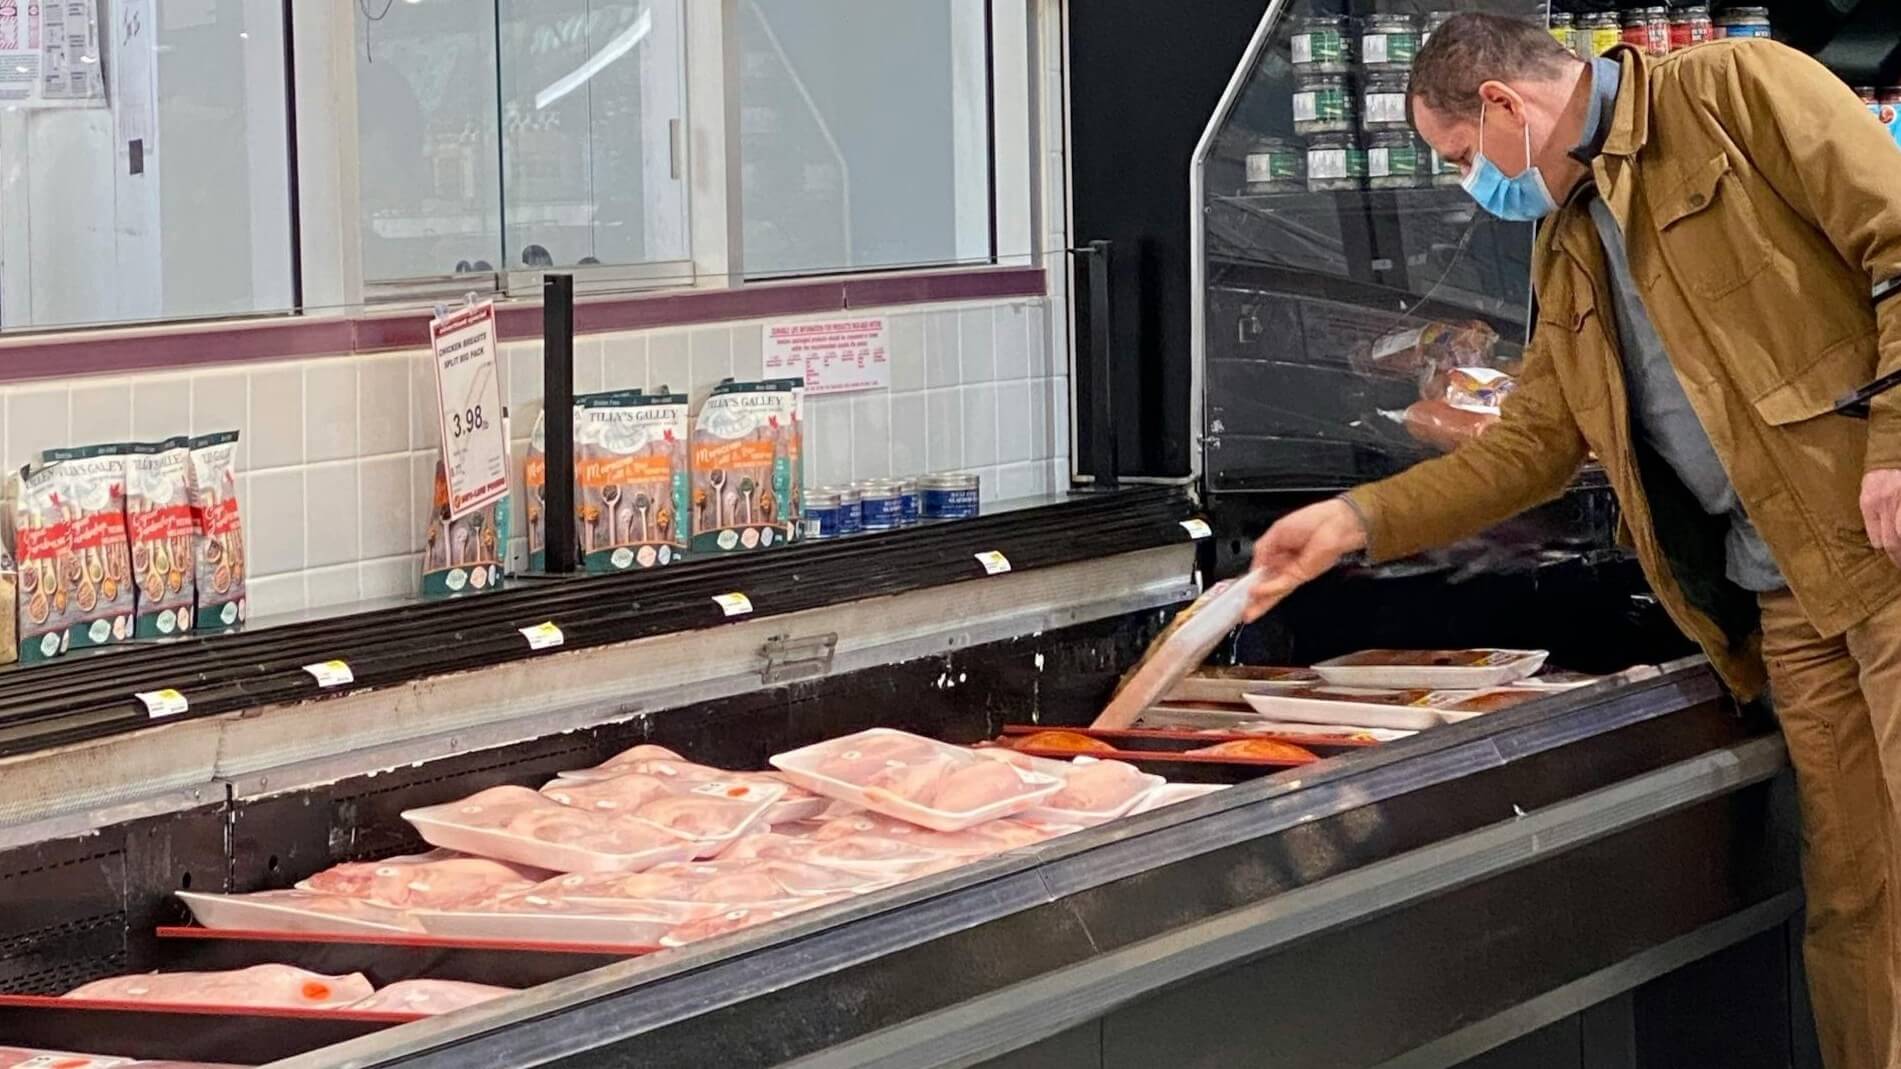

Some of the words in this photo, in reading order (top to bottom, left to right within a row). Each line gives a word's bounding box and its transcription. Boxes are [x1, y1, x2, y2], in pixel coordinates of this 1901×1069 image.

[439, 342, 462, 357] CHICKEN
[463, 332, 487, 347] BREASTS
[444, 357, 459, 368] SPLIT
[470, 347, 485, 359] PACK
[453, 405, 482, 438] 3.98
